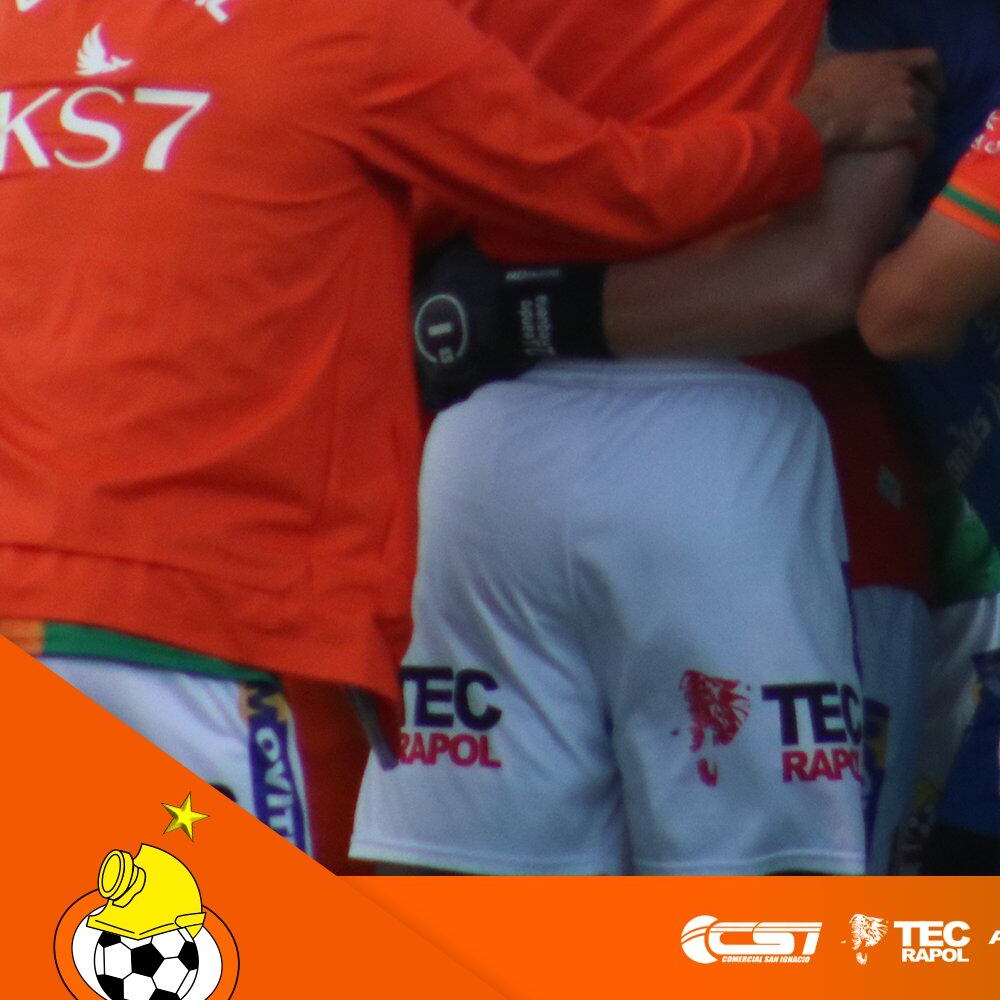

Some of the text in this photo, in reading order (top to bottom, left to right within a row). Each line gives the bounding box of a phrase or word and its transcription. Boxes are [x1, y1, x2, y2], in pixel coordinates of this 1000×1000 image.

[0, 86, 211, 172] KS7
[761, 682, 862, 746] TEC
[782, 749, 862, 783] RAP
